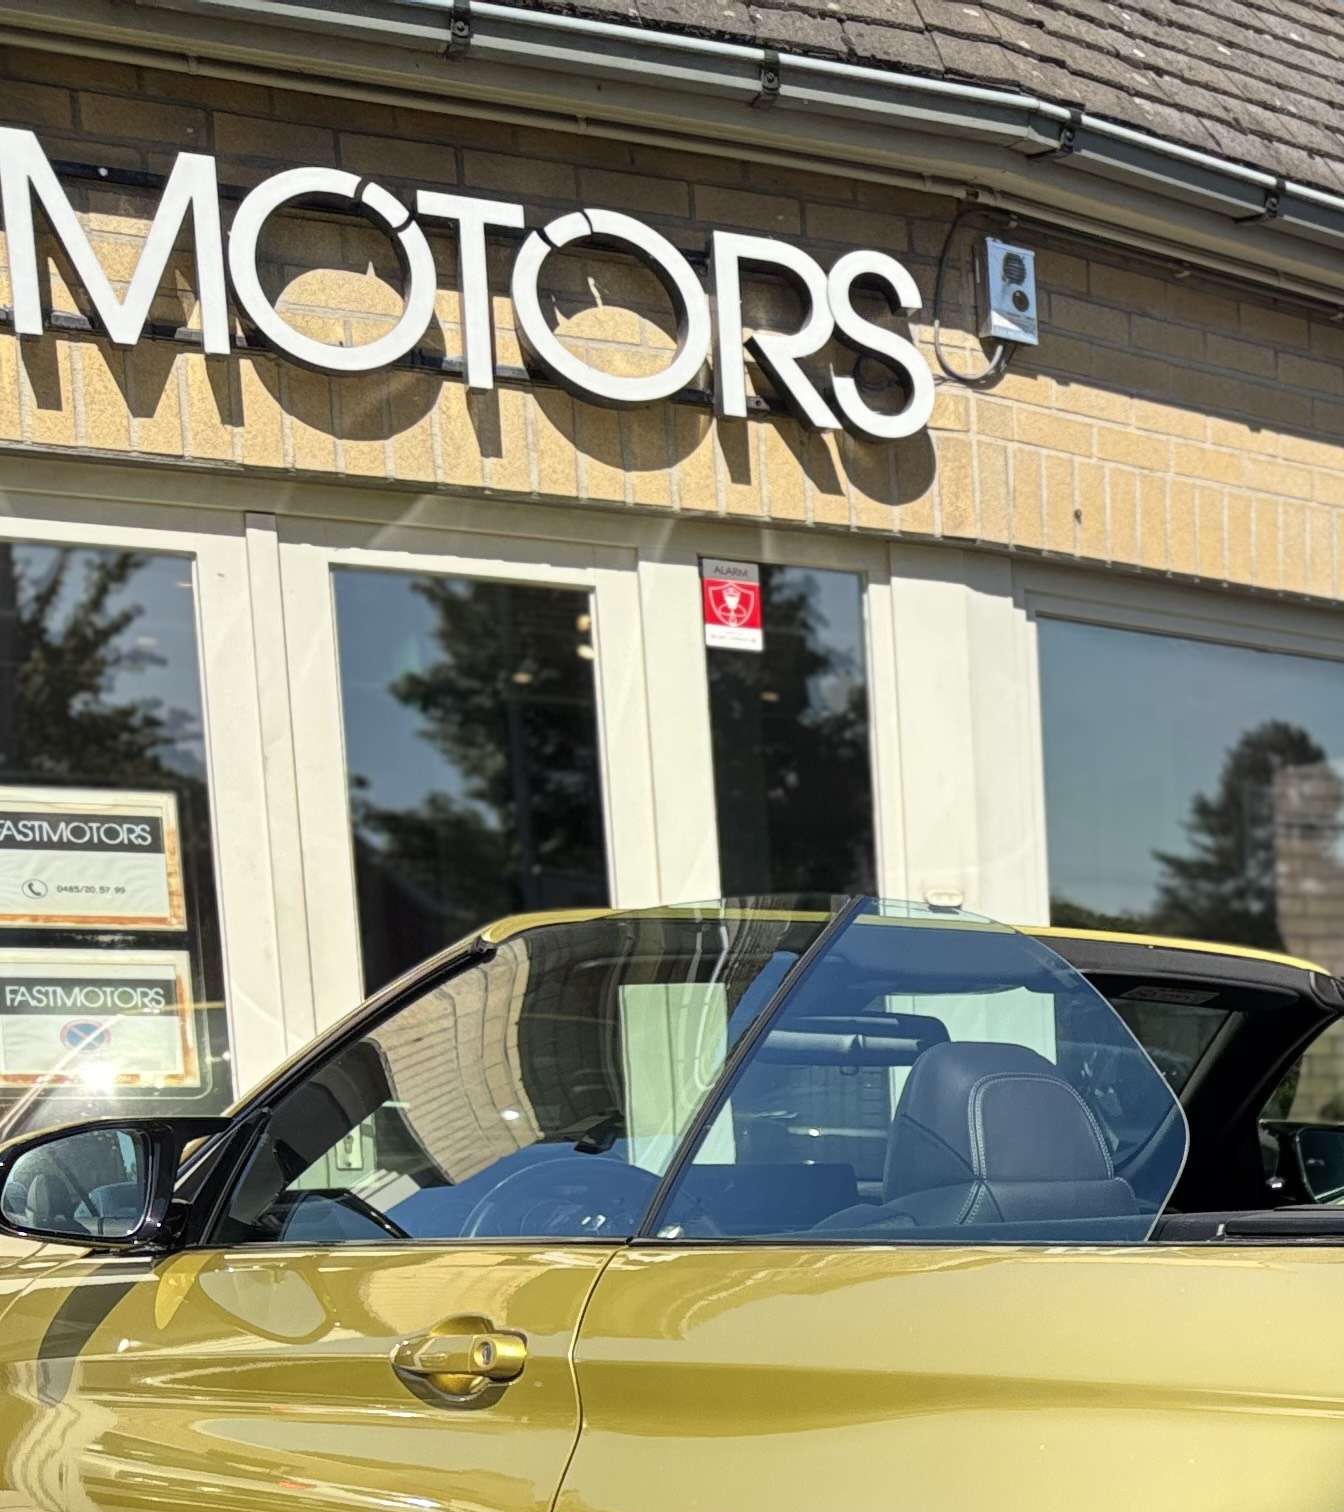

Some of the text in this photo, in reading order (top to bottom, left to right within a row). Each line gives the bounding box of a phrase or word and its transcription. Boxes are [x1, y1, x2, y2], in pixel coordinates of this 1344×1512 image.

[0, 126, 936, 439] MOTORS
[713, 565, 749, 577] ALARM
[5, 985, 166, 1009] FASTMOTORS
